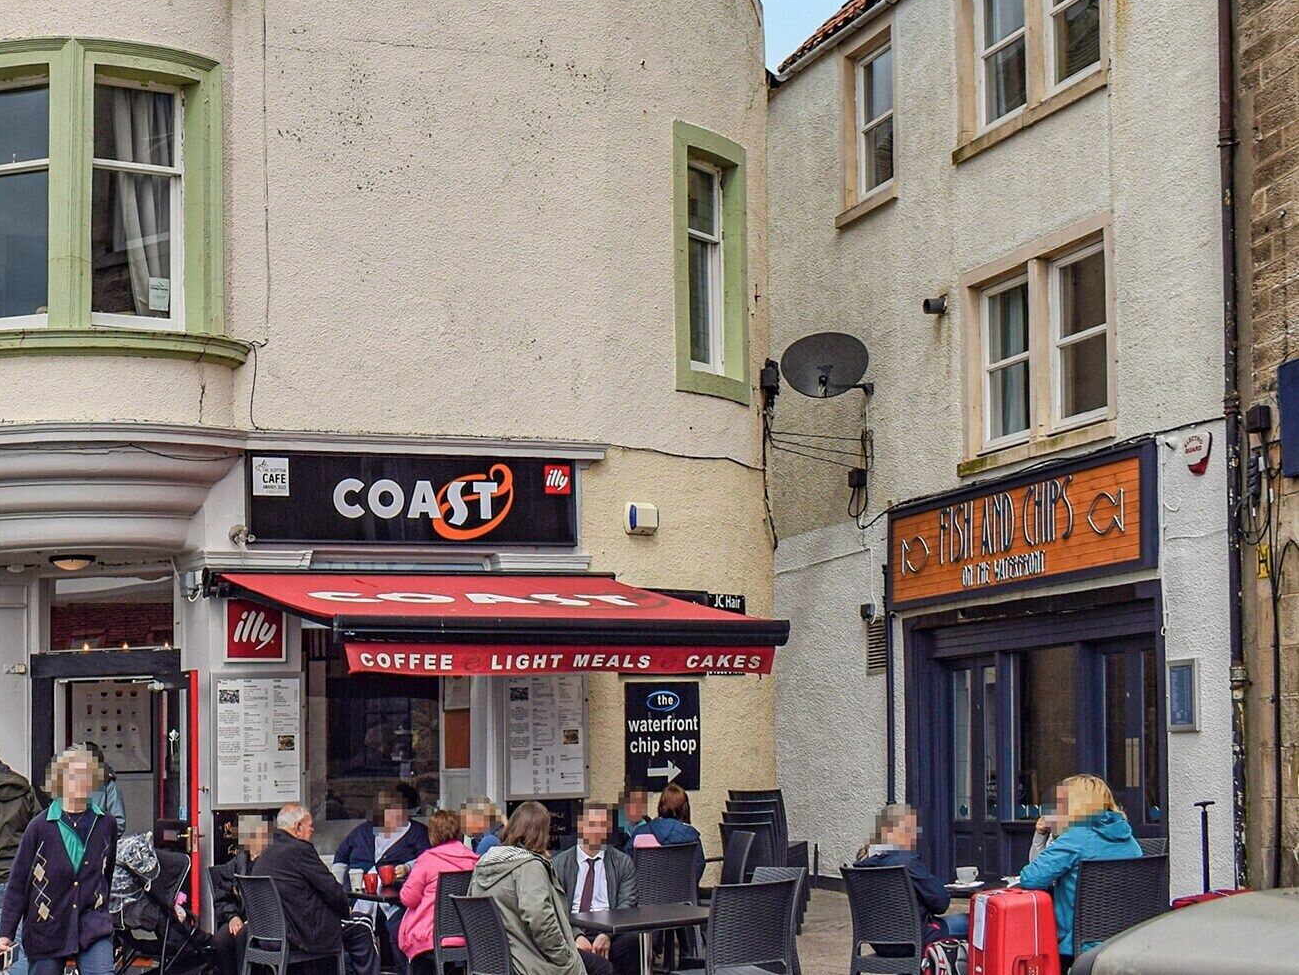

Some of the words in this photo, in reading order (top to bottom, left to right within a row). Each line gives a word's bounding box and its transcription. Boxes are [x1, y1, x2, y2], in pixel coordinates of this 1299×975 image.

[1185, 445, 1202, 454] GUARD
[262, 473, 286, 484] CAFE
[545, 469, 569, 491] illy
[333, 478, 498, 526] COAST
[940, 500, 974, 565] FISH
[982, 492, 1015, 556] AND
[1023, 475, 1074, 546] CHIPS
[962, 564, 974, 587] ON
[977, 561, 991, 585] THE
[993, 549, 1046, 582] WATERFRONT
[307, 591, 639, 606] COAST
[714, 594, 724, 608] JC
[725, 595, 741, 609] Hair
[233, 610, 277, 651] illy
[359, 652, 454, 670] COFFEE
[491, 654, 563, 671] LIGHT
[572, 653, 652, 669] MEALS
[686, 654, 762, 669] CAKES
[657, 694, 674, 706] the
[628, 715, 699, 732] waterfront
[630, 737, 660, 757] chip
[663, 736, 697, 756] shop
